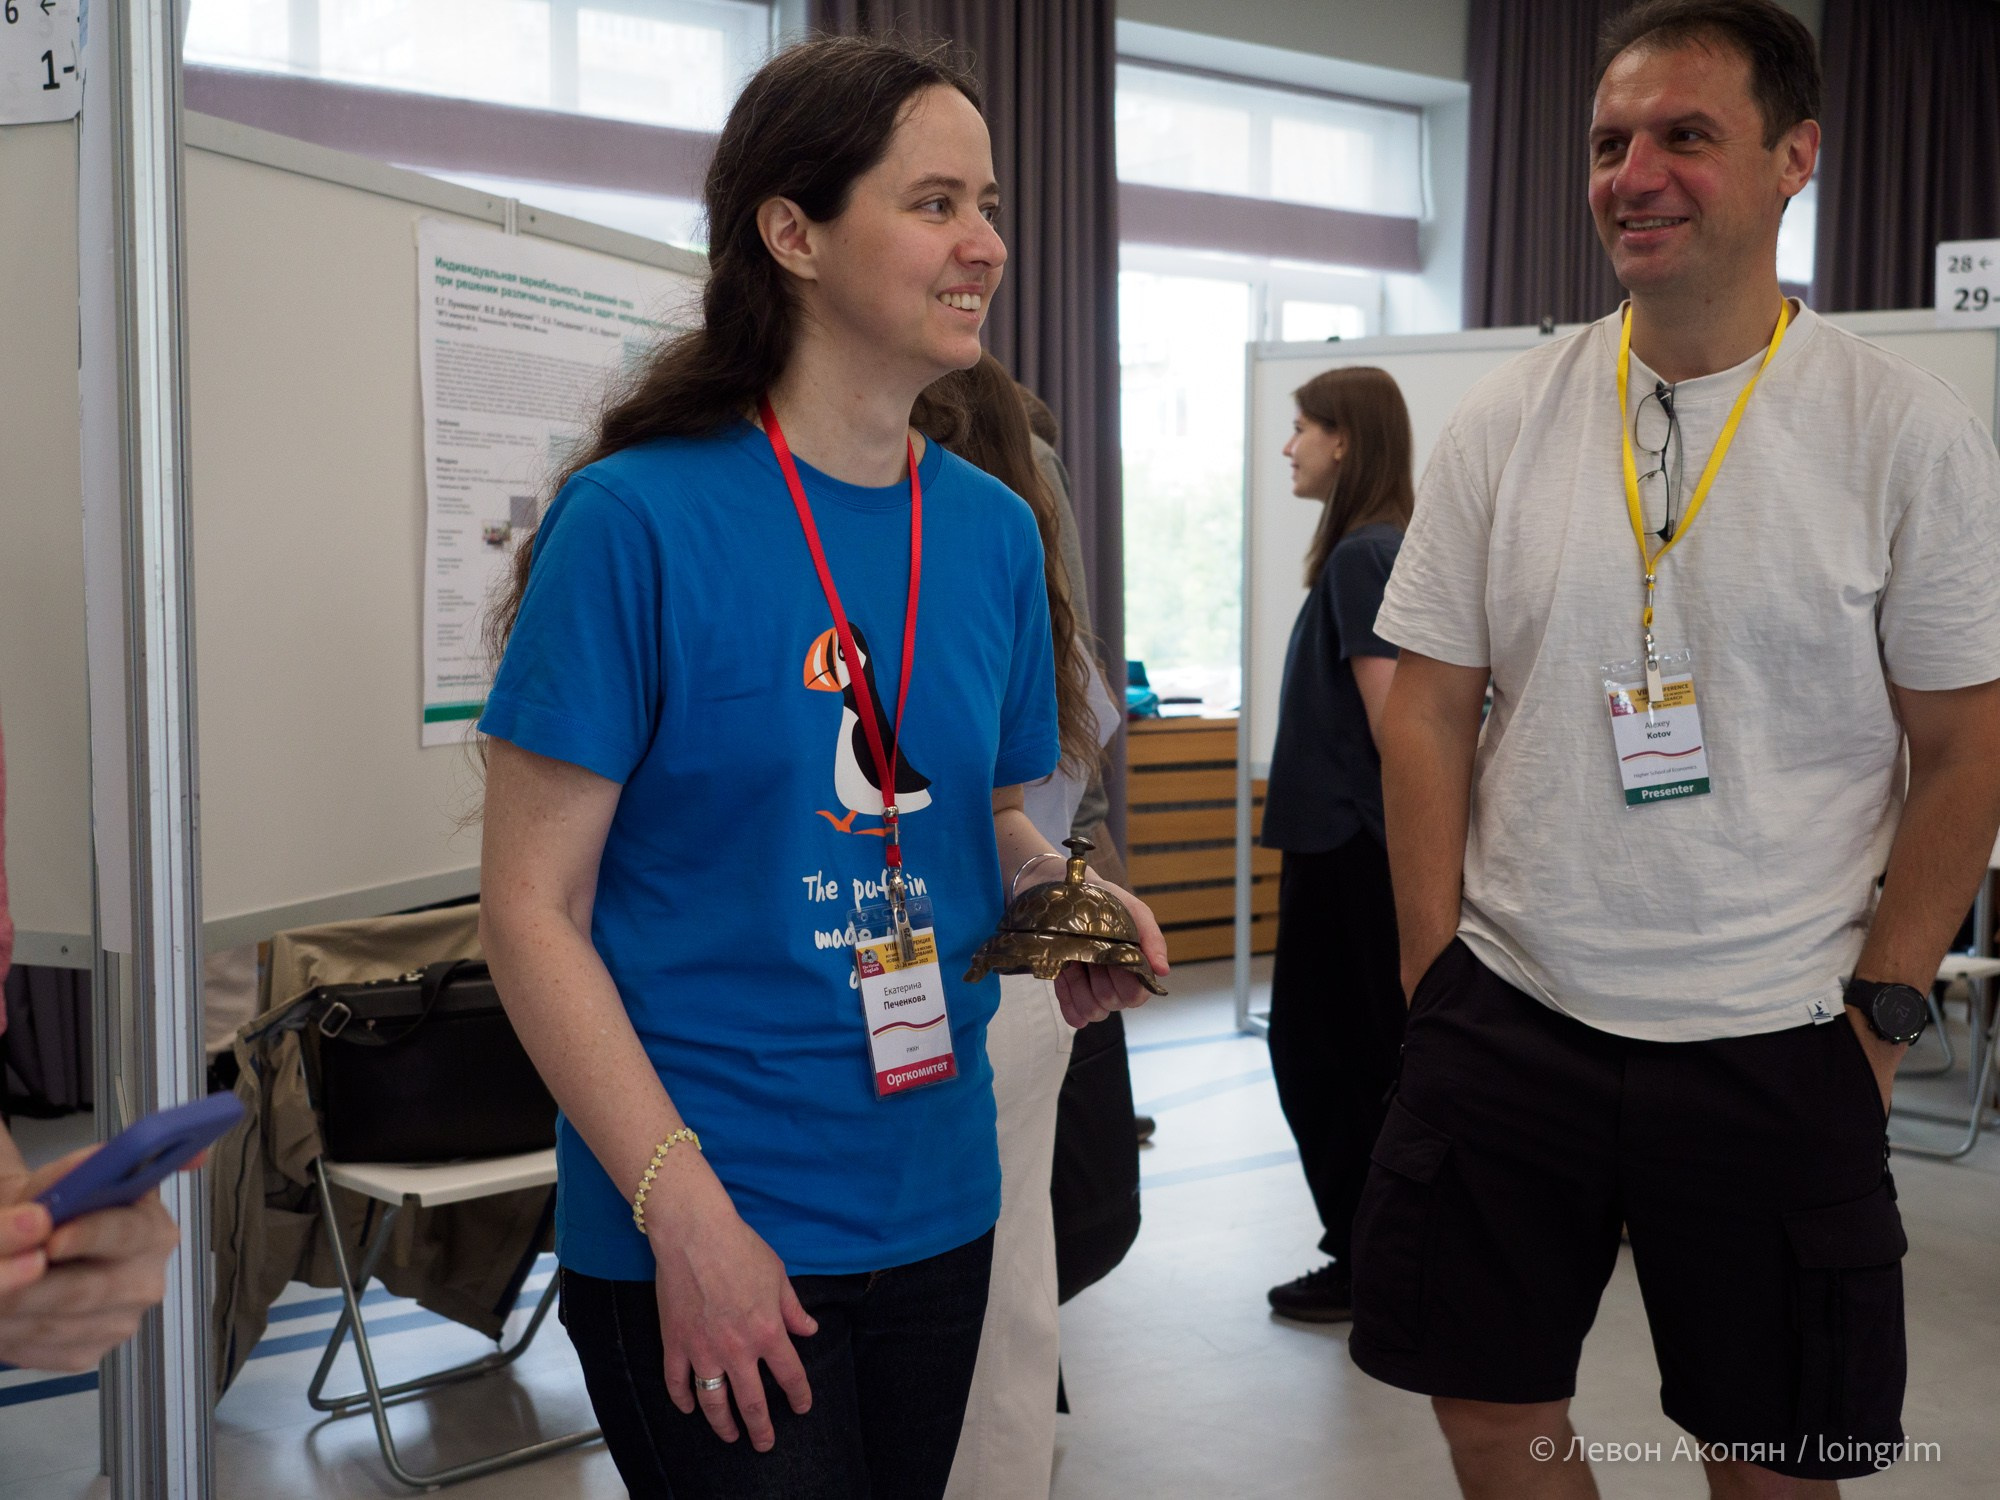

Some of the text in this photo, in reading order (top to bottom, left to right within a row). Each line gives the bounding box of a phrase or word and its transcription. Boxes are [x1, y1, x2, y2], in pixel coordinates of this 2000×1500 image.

[1948, 255, 1973, 274] 28
[435, 274, 453, 288] при
[456, 278, 498, 295] решении
[1645, 720, 1670, 730] Alexey
[1647, 731, 1671, 740] Kotov
[1641, 784, 1694, 800] Presenter
[802, 868, 928, 914] The pufin
[884, 981, 922, 996] Екатерина
[884, 993, 926, 1010] Печенкова
[886, 1061, 948, 1087] Оргкомитет
